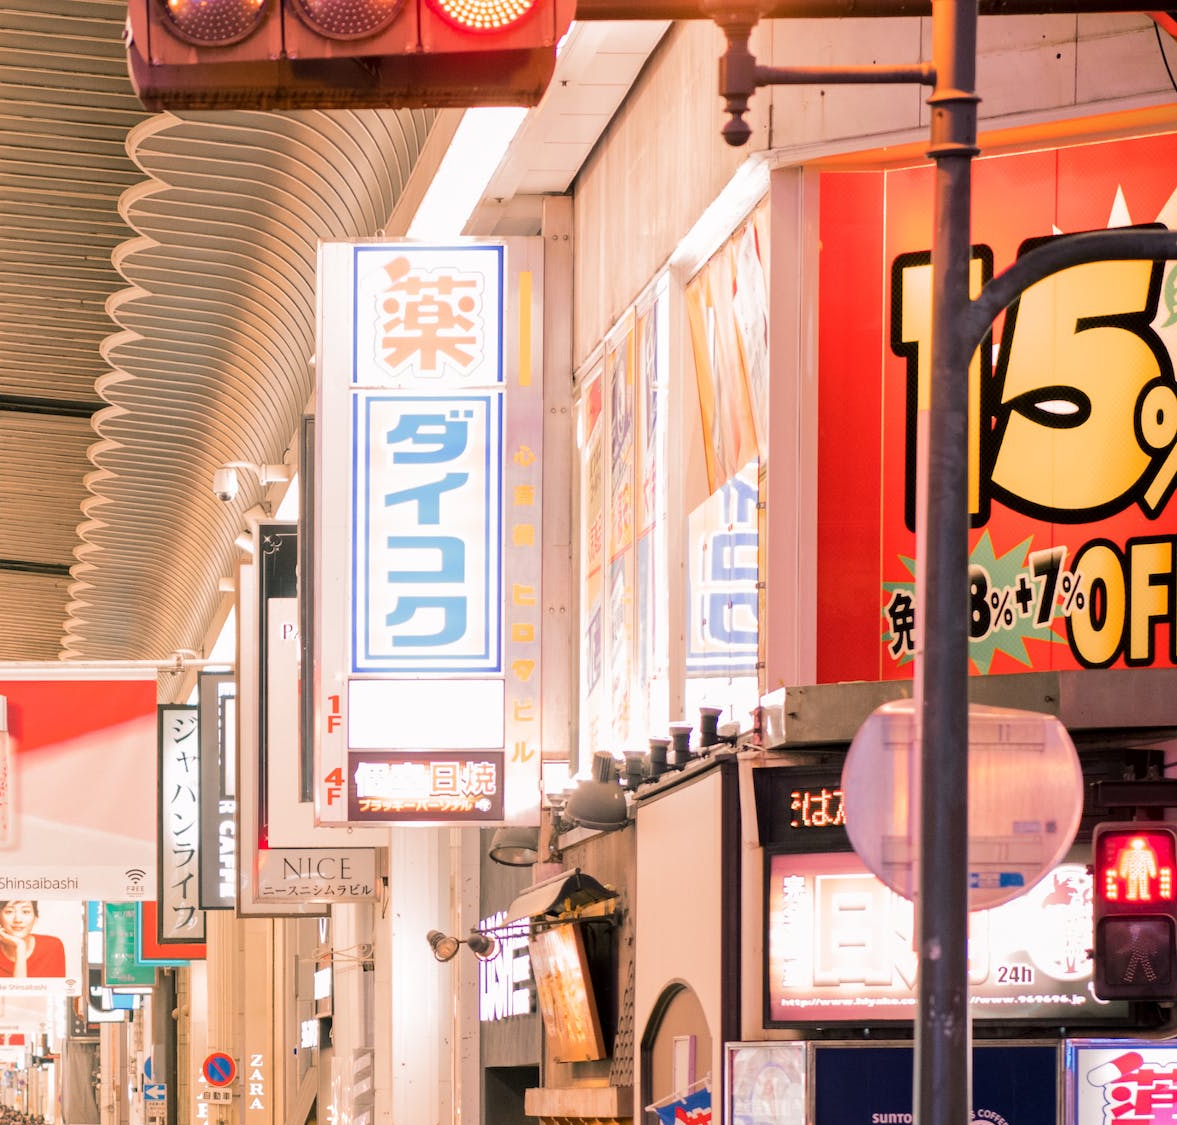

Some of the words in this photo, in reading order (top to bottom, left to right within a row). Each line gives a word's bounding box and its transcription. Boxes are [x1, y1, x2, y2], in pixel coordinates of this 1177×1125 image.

[376, 255, 479, 371] 薬
[384, 409, 474, 647] ダイコク
[1067, 537, 1177, 668] OF
[327, 695, 342, 733] 1F
[324, 767, 345, 806] 4F
[355, 761, 496, 796] 日焼
[171, 715, 200, 930] ジャハンライフ
[283, 857, 352, 881] NICE
[263, 884, 372, 896] ニースニシムラビル
[997, 966, 1033, 984] 24h
[970, 993, 1086, 1008] //www.969696.jp
[249, 1054, 264, 1110] ZARA
[872, 1113, 913, 1124] SUNTO
